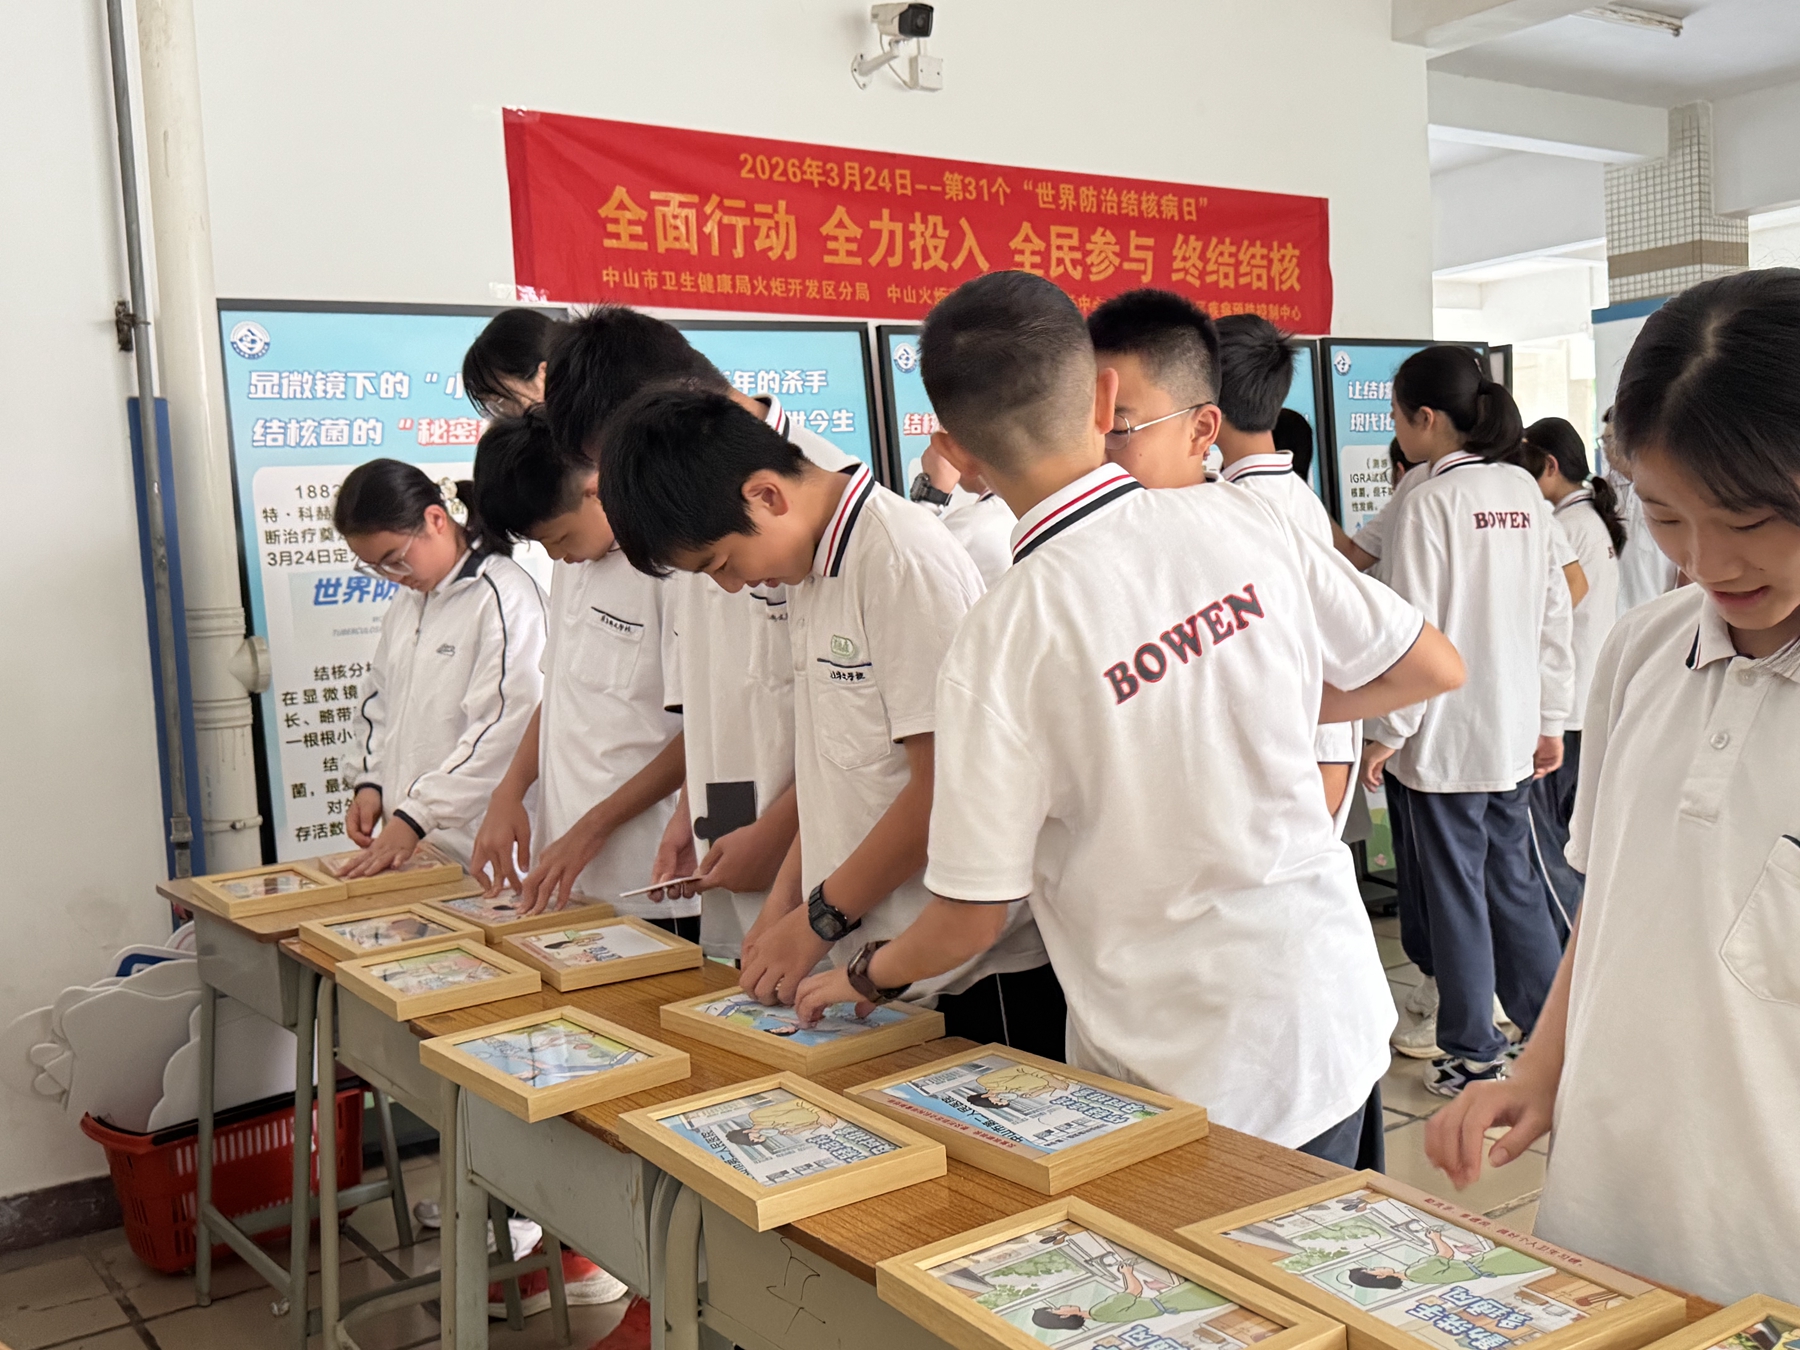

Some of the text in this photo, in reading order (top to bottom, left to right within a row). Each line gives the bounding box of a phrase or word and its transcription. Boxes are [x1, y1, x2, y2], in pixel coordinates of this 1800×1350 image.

[598, 185, 1301, 292] 全面行动 全力投入 全民参与 终结结核
[602, 266, 870, 302] 中山市卫生健康局火炬开发区分局
[887, 284, 957, 306] 中山火炬
[722, 369, 828, 395] 年的杀手
[1473, 512, 1531, 529] BOWEN
[264, 526, 346, 545] 断治疗奠
[267, 548, 358, 567] 3月24日定
[1103, 583, 1265, 705] BOWEN
[285, 706, 357, 728] 长、略带
